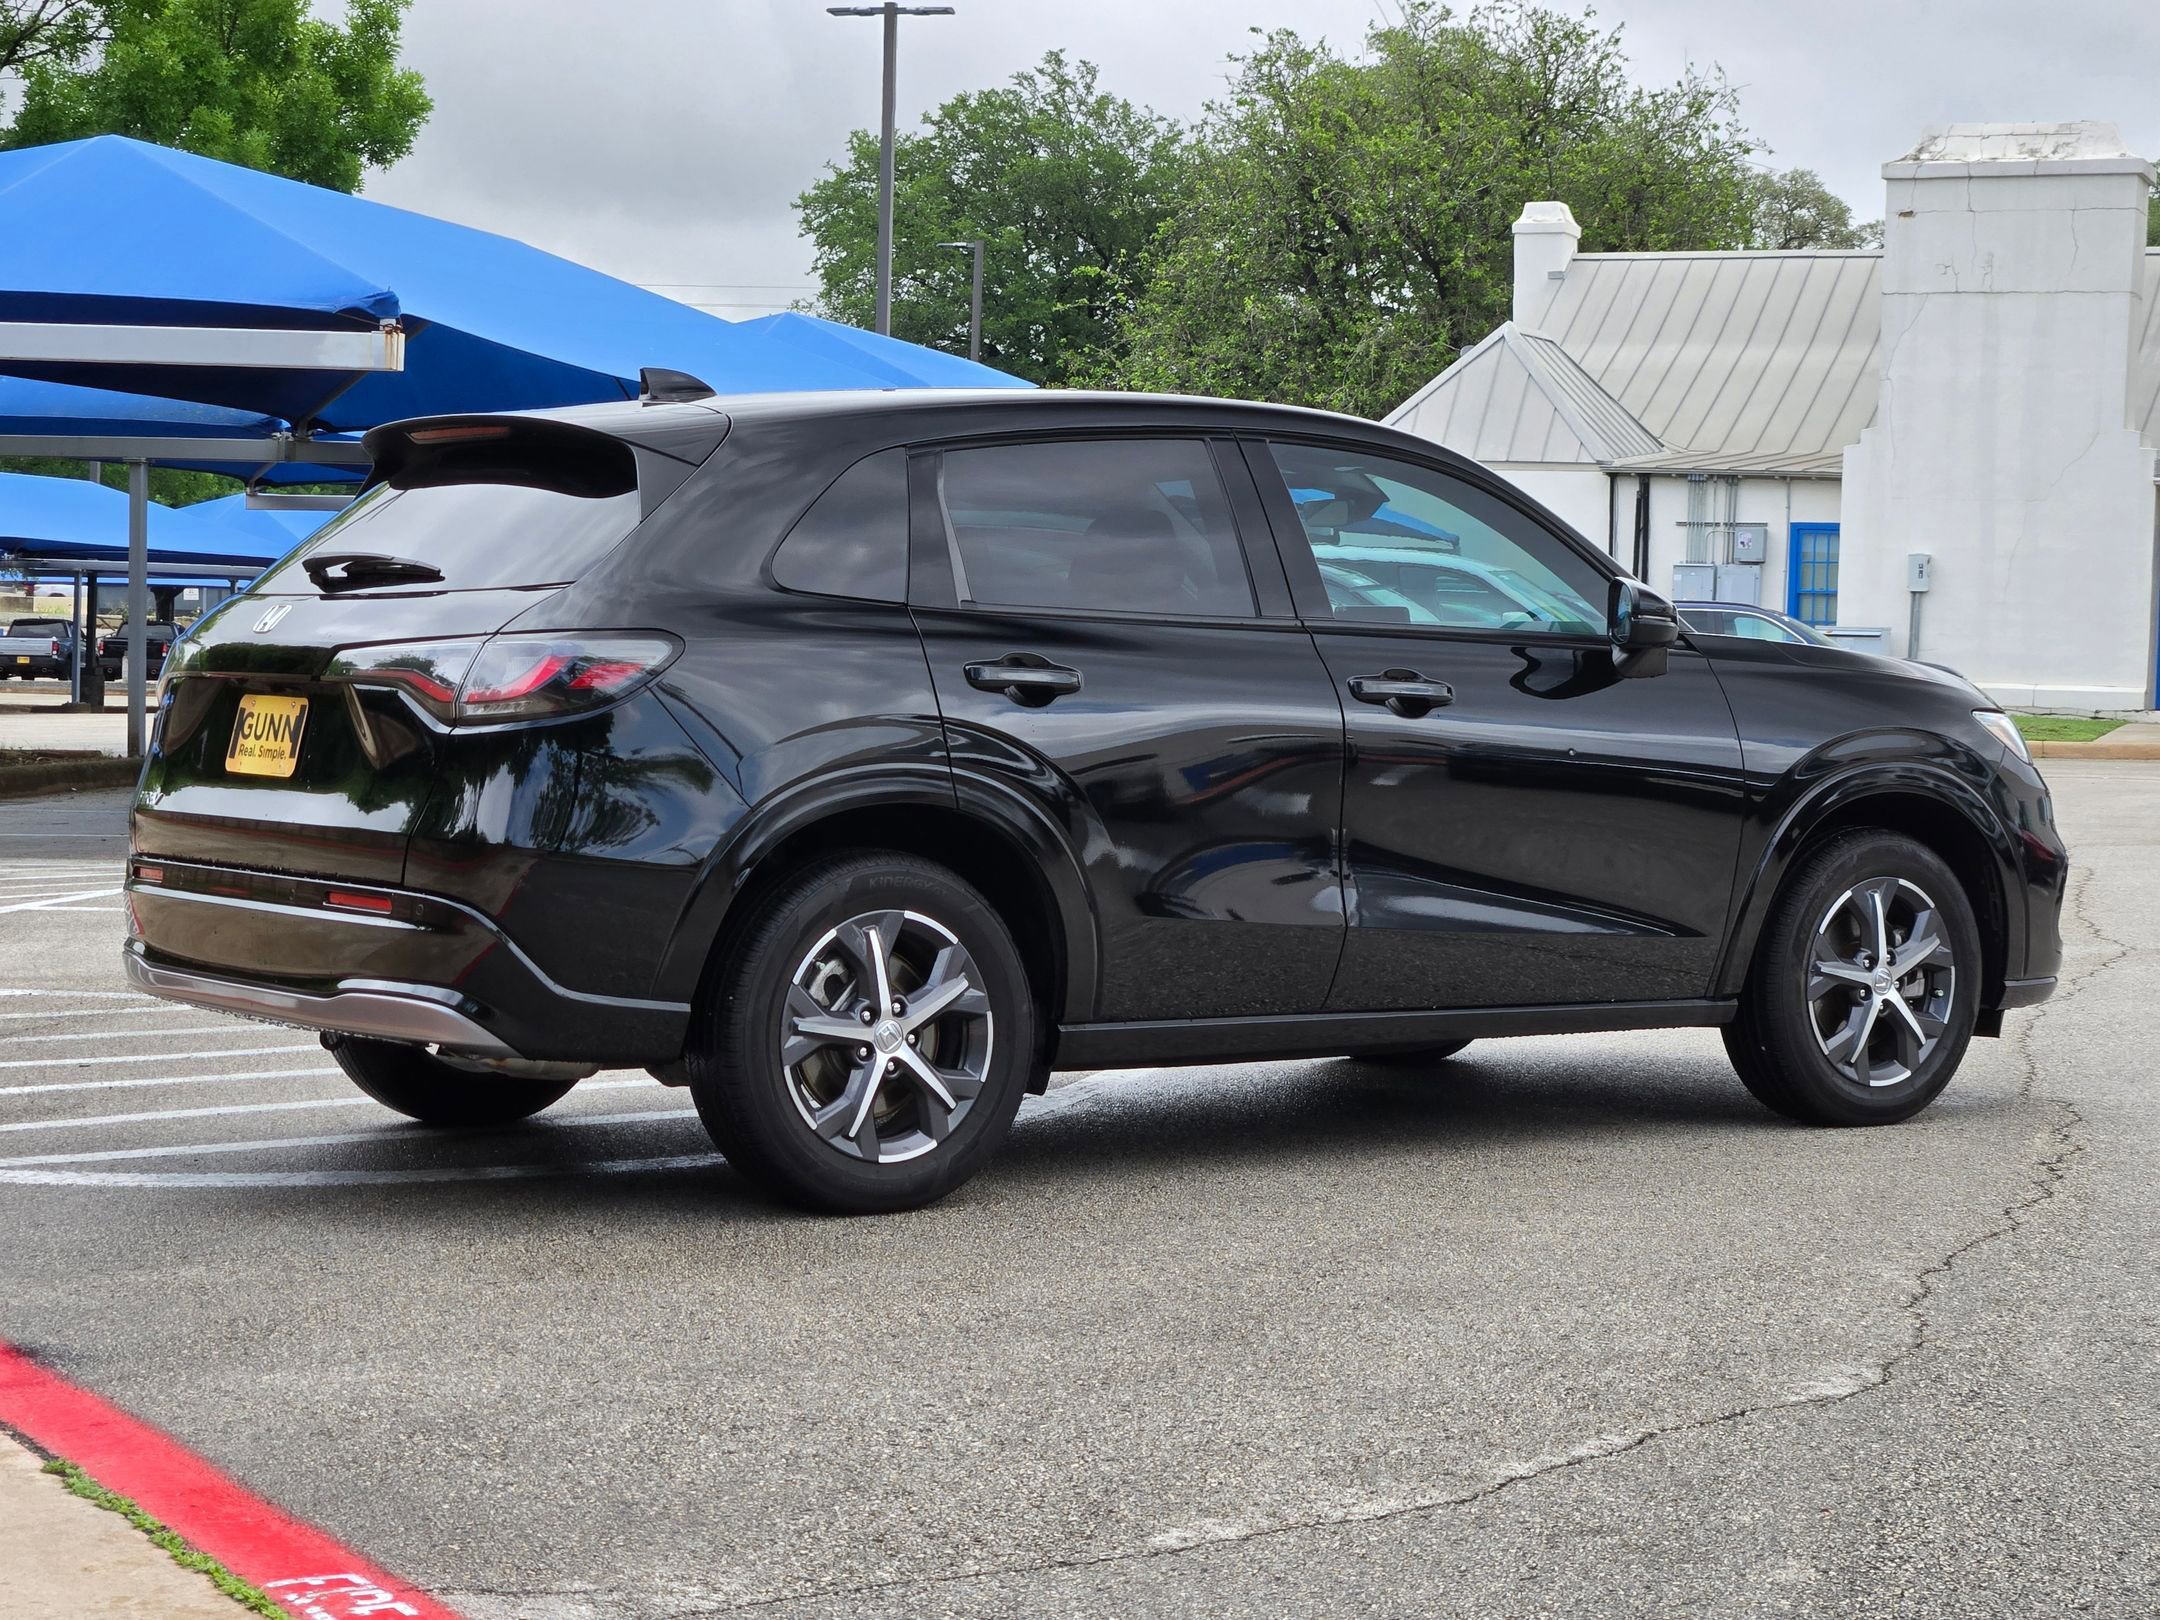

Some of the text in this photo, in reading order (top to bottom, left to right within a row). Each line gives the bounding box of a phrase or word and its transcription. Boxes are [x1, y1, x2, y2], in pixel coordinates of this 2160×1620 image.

[240, 711, 300, 743] GUNN
[238, 744, 286, 761] Real. Simple.
